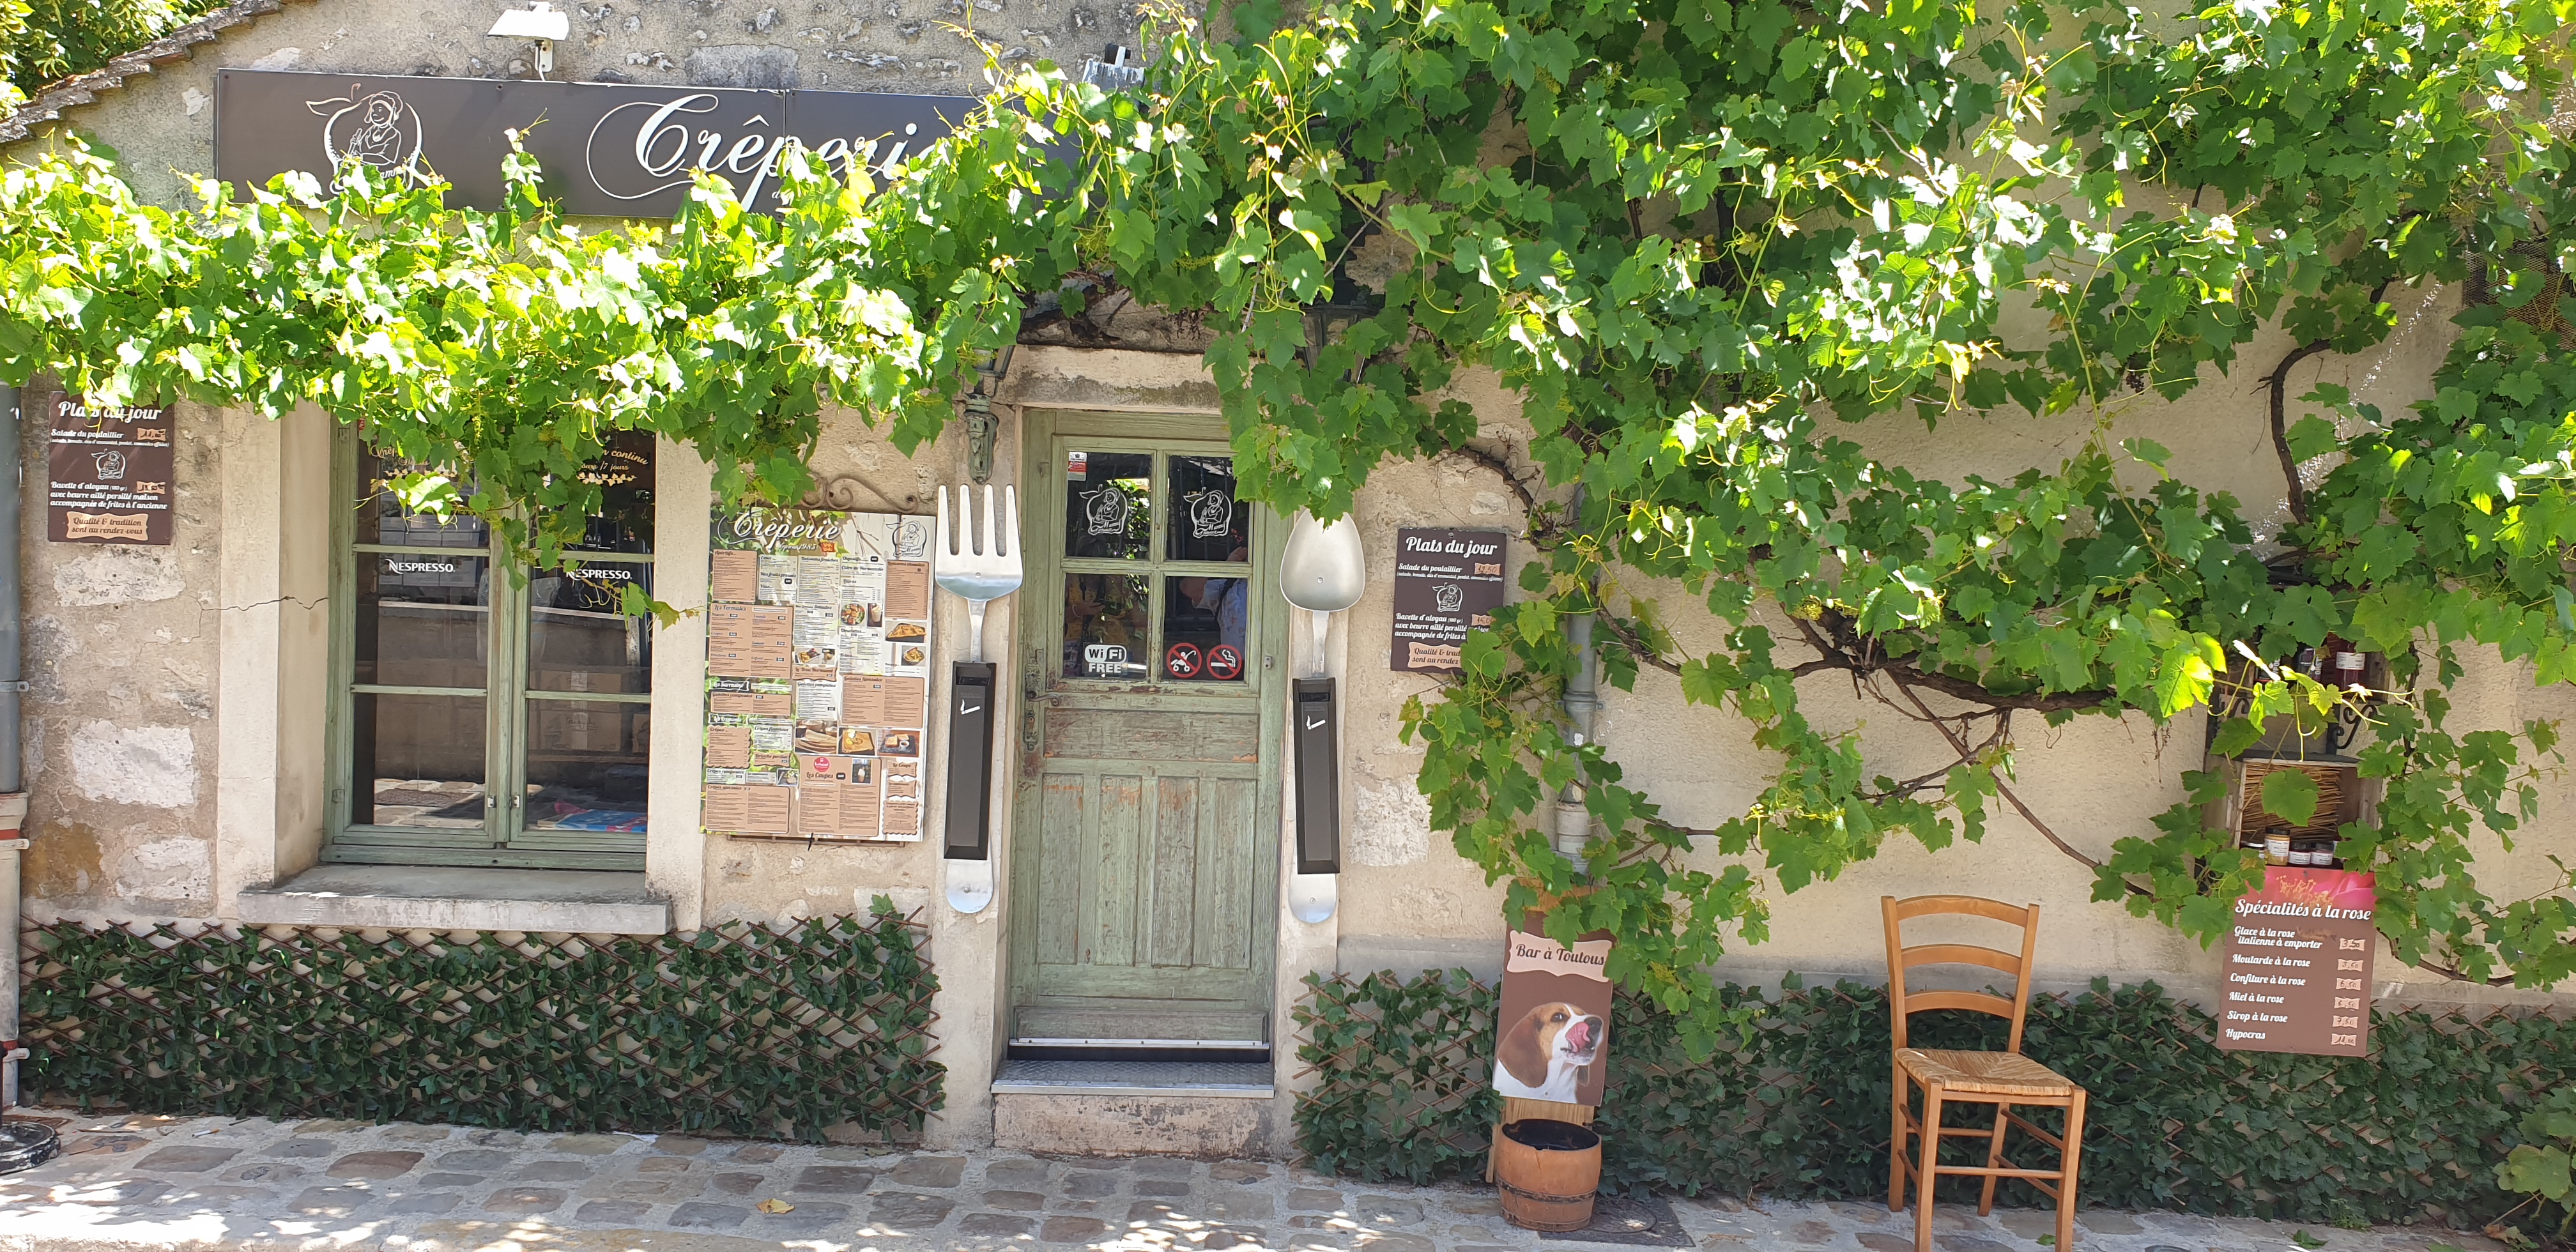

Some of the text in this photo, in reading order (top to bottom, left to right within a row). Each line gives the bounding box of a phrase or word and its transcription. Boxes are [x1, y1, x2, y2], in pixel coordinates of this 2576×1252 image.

[586, 93, 950, 212] Crêperi
[58, 401, 101, 418] Plas
[125, 405, 162, 424] jour
[50, 429, 77, 437] Salade
[611, 449, 648, 465] continu
[50, 481, 77, 489] Bavette
[106, 492, 132, 501] persillé
[50, 500, 97, 509] accompagnée
[106, 501, 125, 510] frites
[73, 517, 100, 525] Qualité
[109, 518, 142, 526] tradition
[717, 509, 841, 550] Crêperie
[1406, 536, 1498, 558] Plats du jour
[385, 558, 455, 574] NESPRESSO
[1444, 624, 1468, 632] persillé
[1394, 631, 1436, 639] accompagnée
[1443, 632, 1460, 641] frites
[1088, 663, 1122, 673] FREE
[2235, 899, 2372, 920] Spécialités à la rose
[2234, 926, 2296, 938] Glace à la rose
[2237, 936, 2322, 950] italienne à emporter
[1516, 943, 1605, 966] Bar à Toutous
[2232, 954, 2311, 967] Moutarde à la rose
[2230, 972, 2268, 985] Confiture
[2270, 975, 2276, 984] à
[2278, 975, 2287, 985] la
[2229, 991, 2247, 1001] Miel
[2248, 993, 2255, 1002] à
[2256, 993, 2266, 1002] la
[2227, 1011, 2288, 1023] Sirop à la rose
[2225, 1028, 2266, 1040] Hypocras
